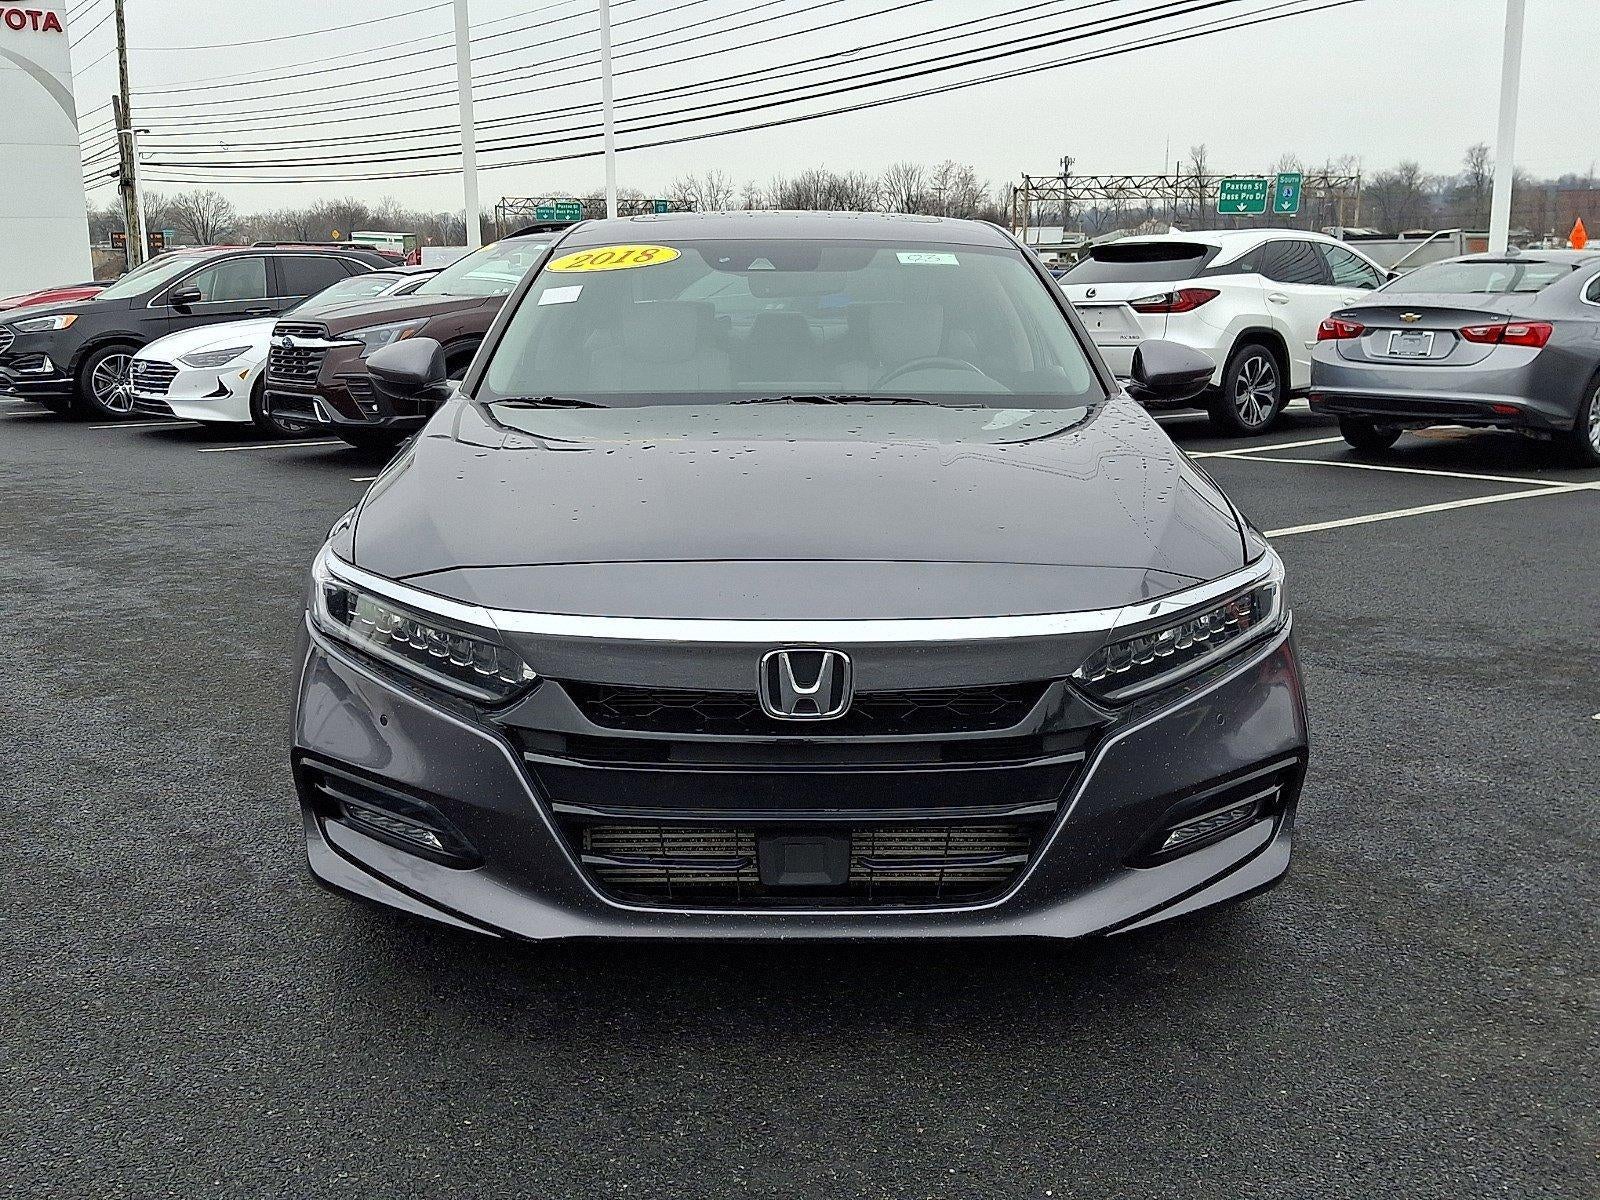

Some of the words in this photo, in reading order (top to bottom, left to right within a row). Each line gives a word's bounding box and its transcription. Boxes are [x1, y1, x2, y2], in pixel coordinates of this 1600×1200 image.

[0, 8, 63, 32] OTA
[1225, 182, 1253, 190] Paxton
[1253, 182, 1263, 190] St
[565, 248, 660, 269] 2018
